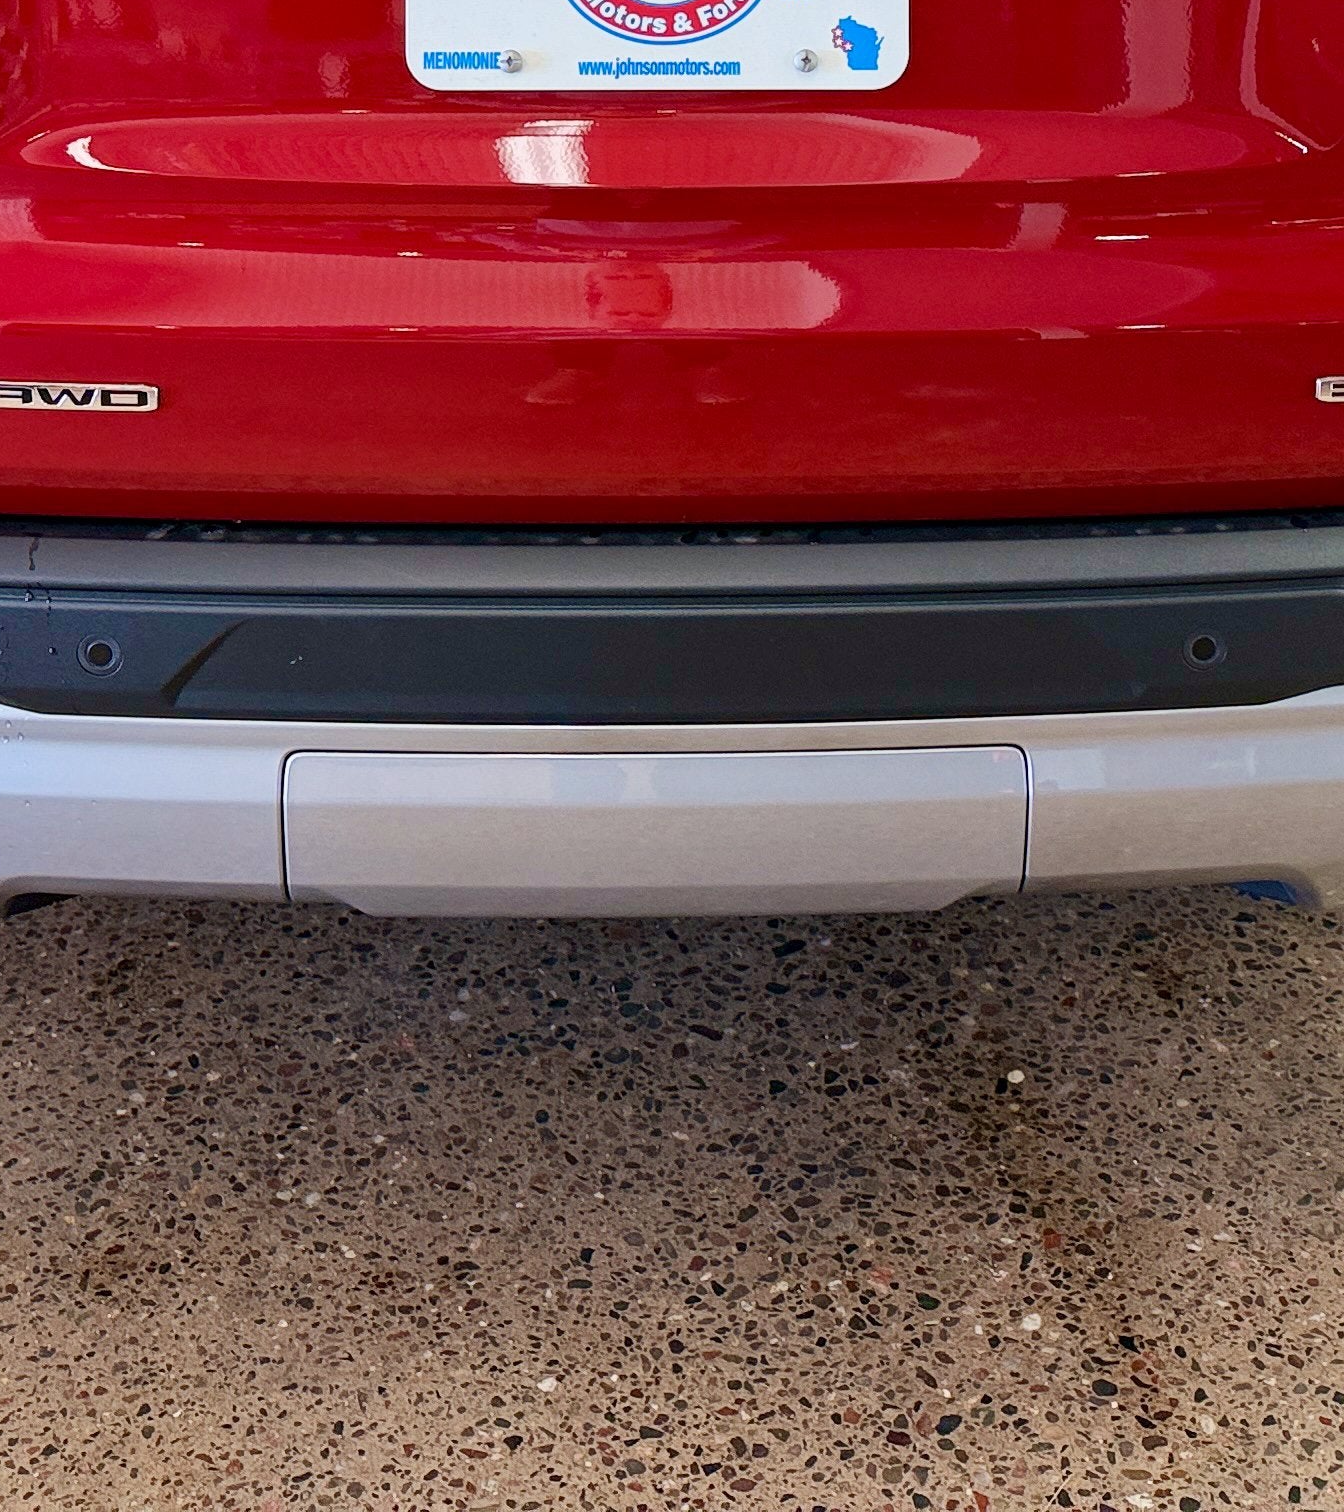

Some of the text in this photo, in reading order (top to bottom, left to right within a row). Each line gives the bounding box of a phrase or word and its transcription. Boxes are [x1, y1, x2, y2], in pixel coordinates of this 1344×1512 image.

[672, 12, 694, 34] &
[423, 51, 501, 70] MENOMONIE
[578, 57, 741, 79] www.johnsonmotors.com
